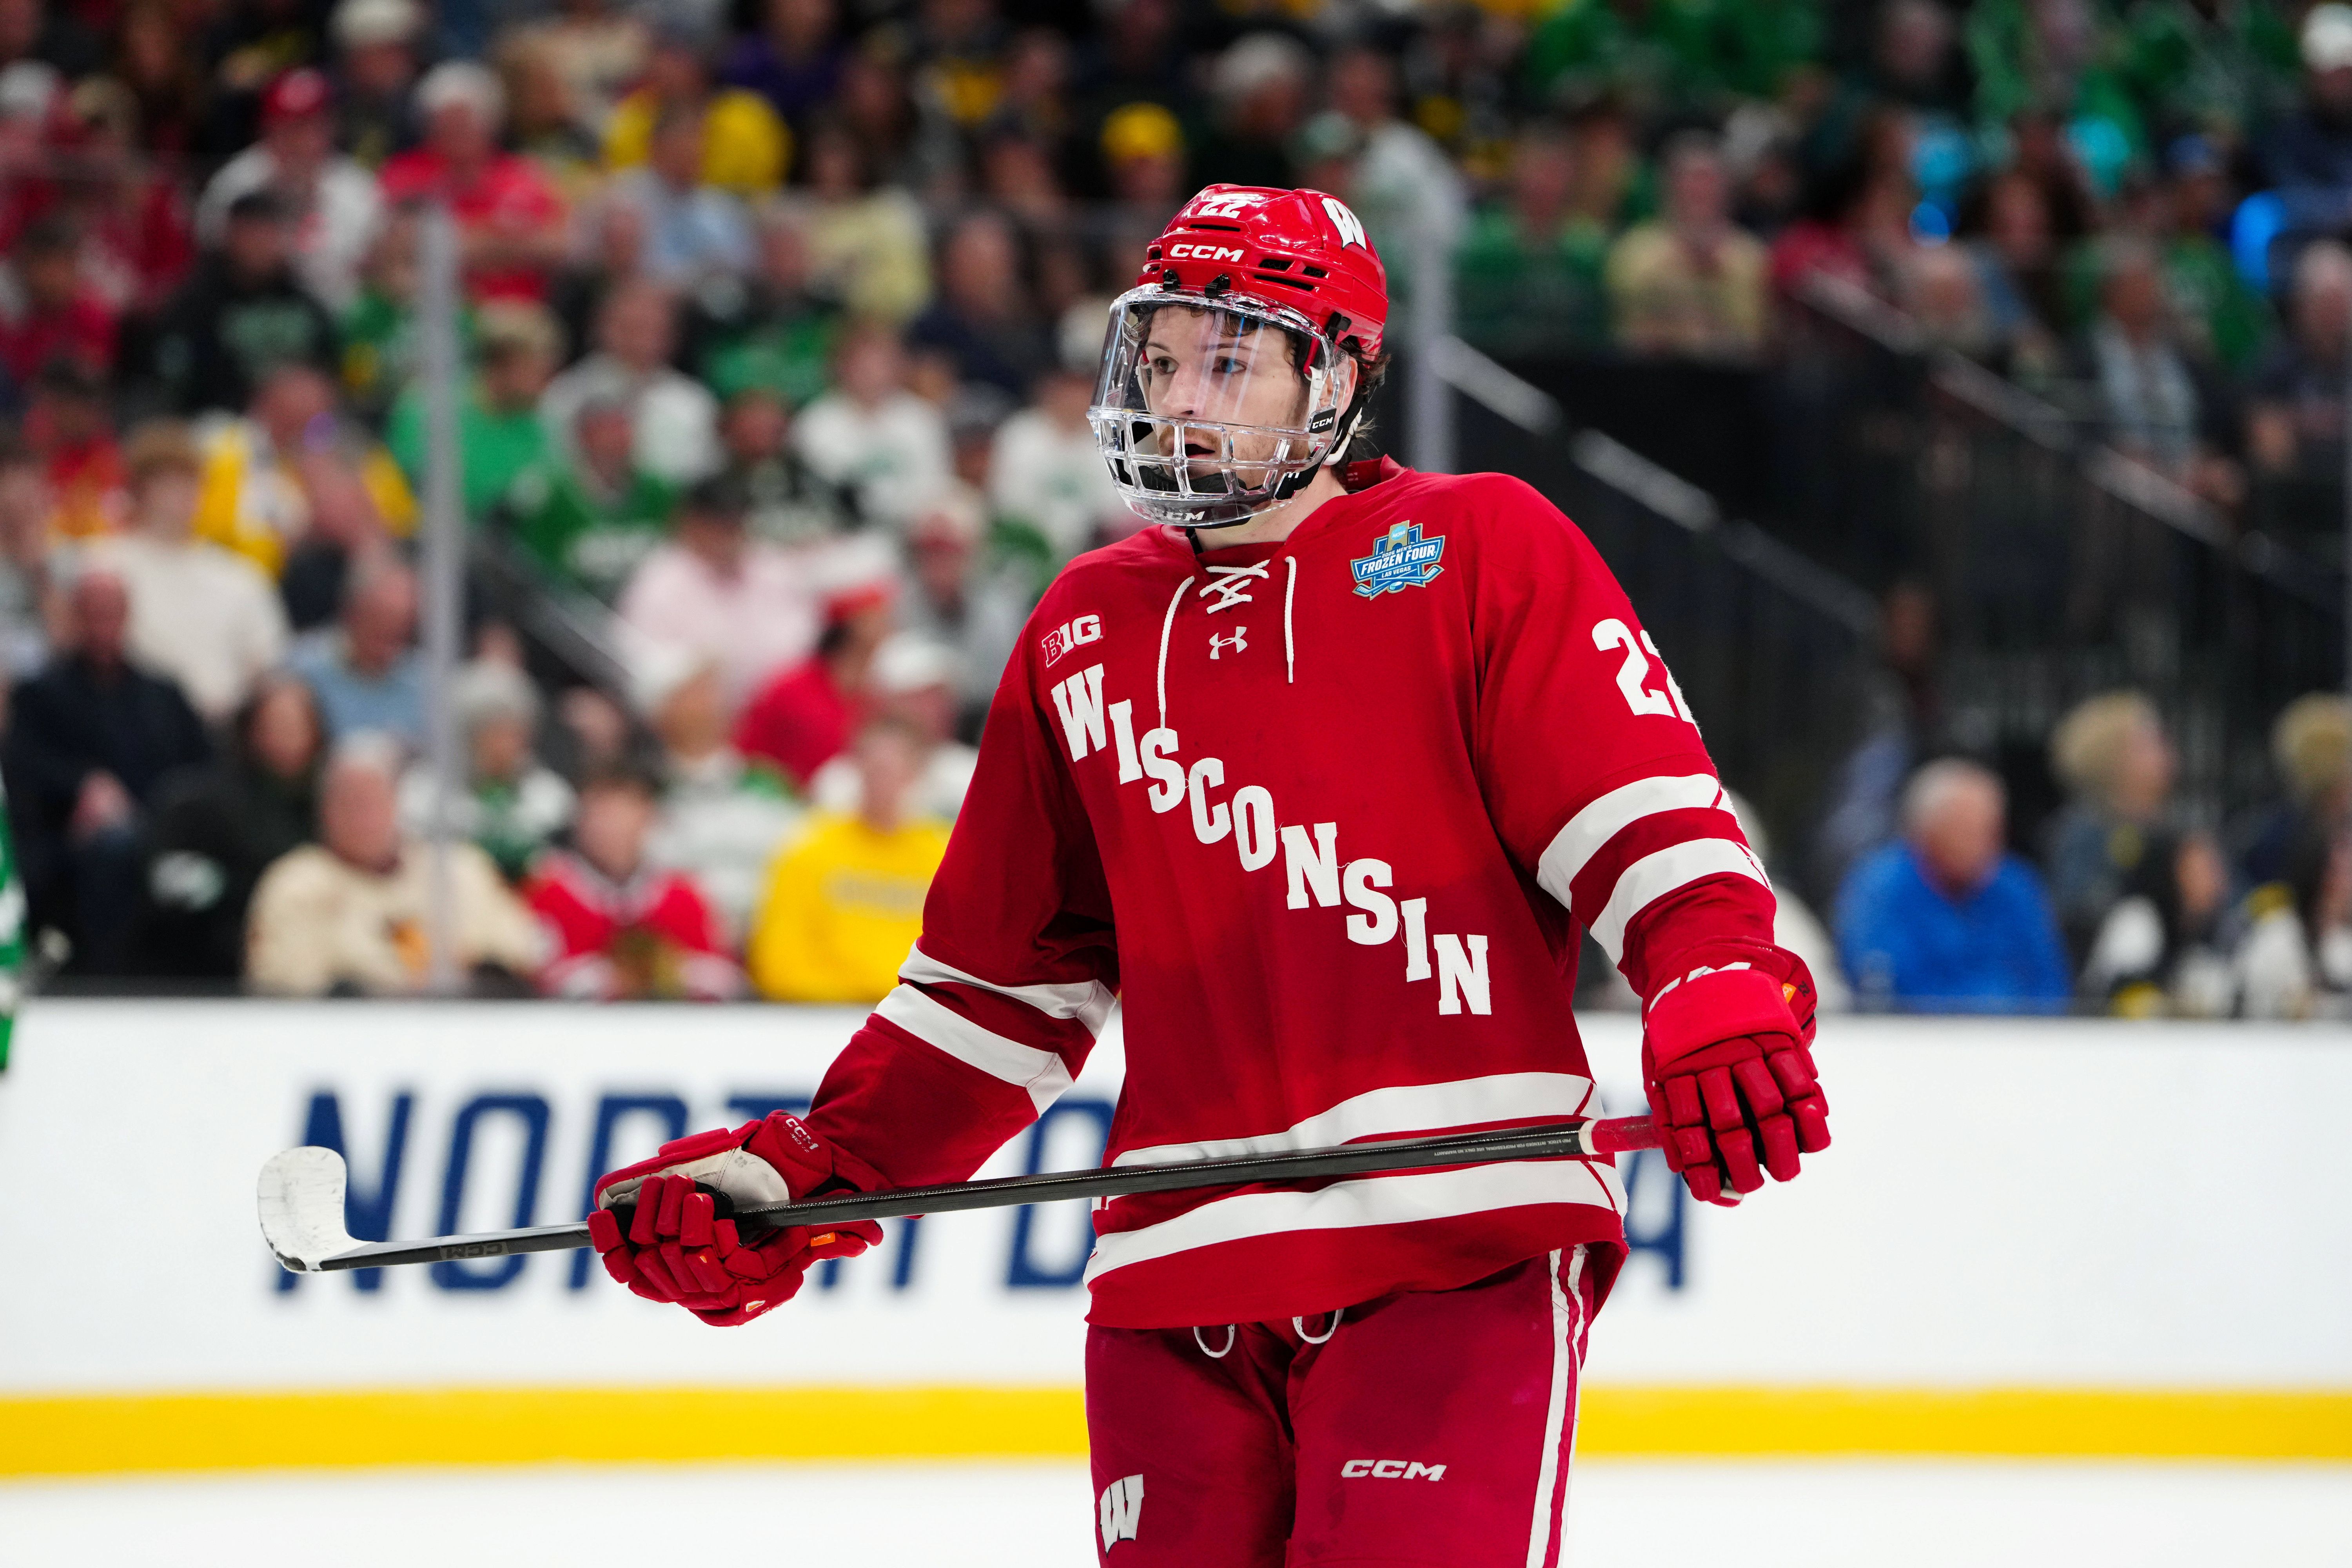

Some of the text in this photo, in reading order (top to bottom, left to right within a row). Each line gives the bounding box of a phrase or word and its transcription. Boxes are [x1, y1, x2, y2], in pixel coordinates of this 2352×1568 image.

[1197, 198, 1248, 219] 22
[1321, 197, 1367, 251] W
[1170, 244, 1244, 262] CCM
[1312, 417, 1333, 429] CCM
[1361, 544, 1436, 575] FROZEN FOUR
[1396, 545, 1412, 553] MEN'S
[1393, 566, 1411, 575] VEGAS
[1051, 663, 1491, 1015] WISCONSIN
[786, 1118, 818, 1149] CCM
[446, 1243, 502, 1259] CCM
[1341, 1460, 1447, 1482] CCM
[1099, 1474, 1144, 1559] W
